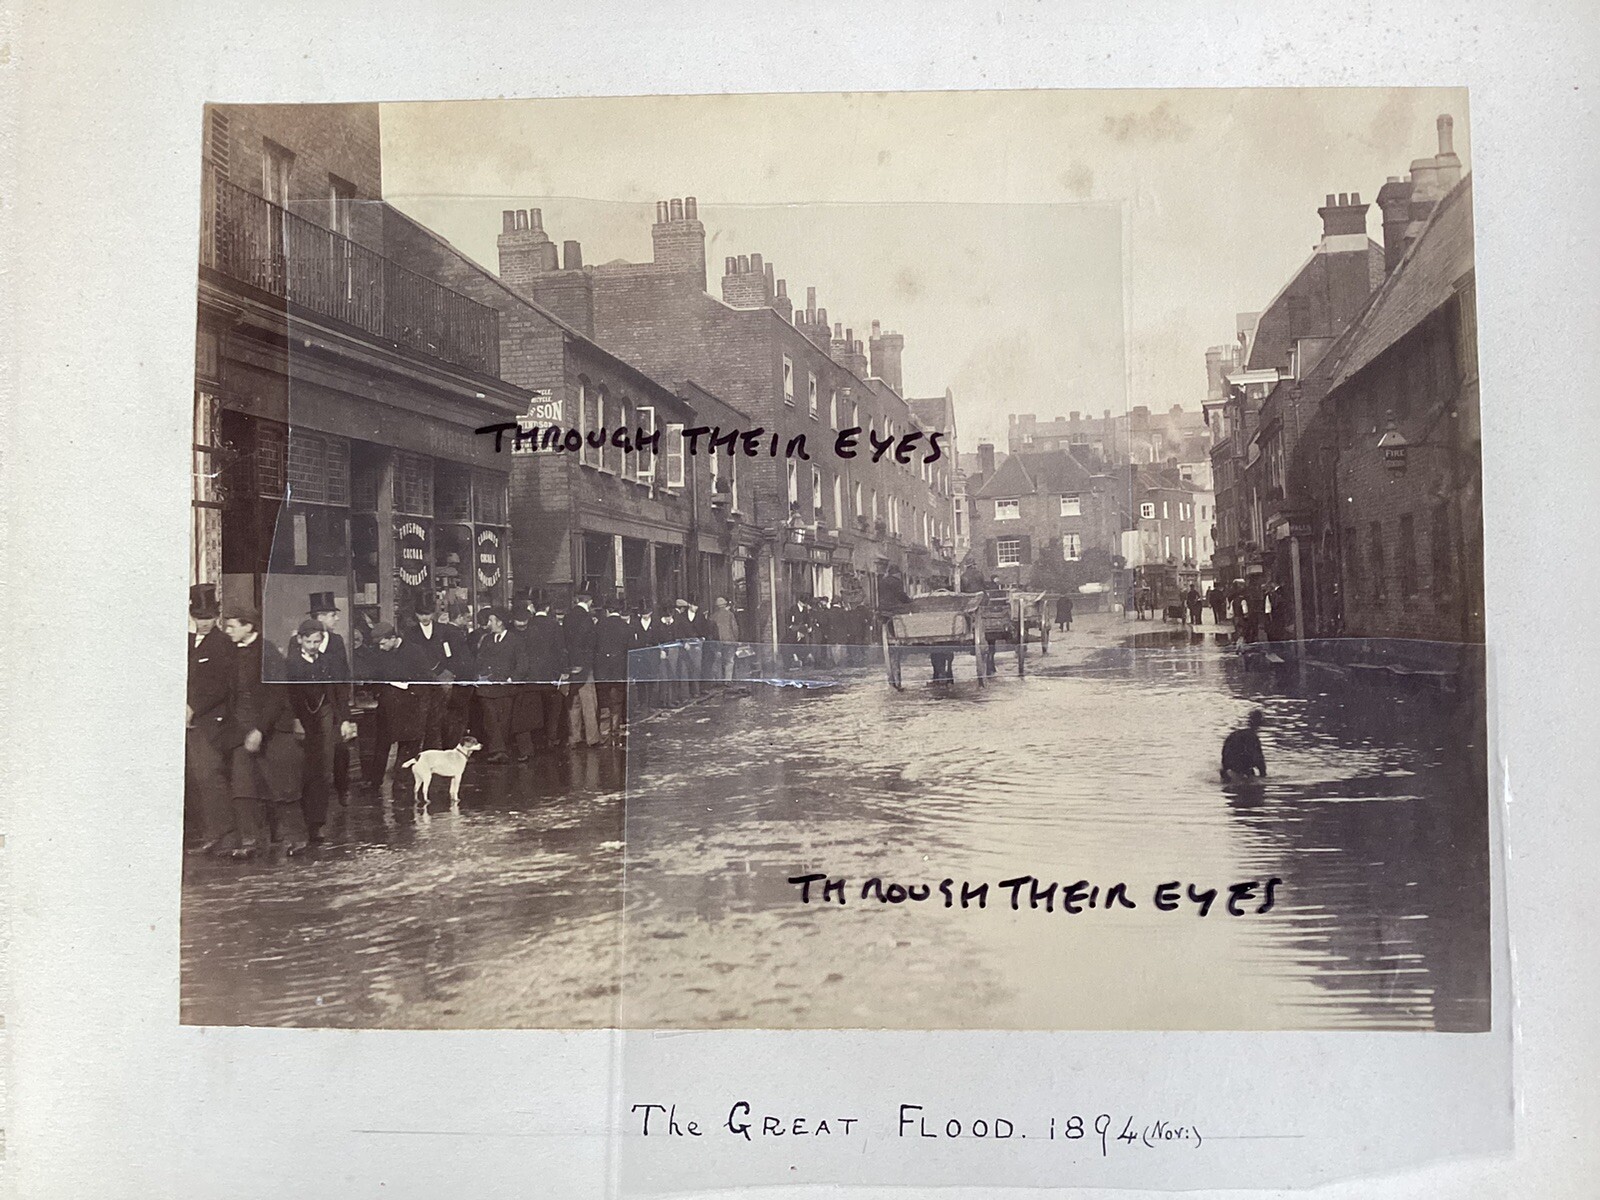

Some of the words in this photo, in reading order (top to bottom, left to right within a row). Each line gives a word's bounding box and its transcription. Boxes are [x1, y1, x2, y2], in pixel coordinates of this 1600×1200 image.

[537, 400, 563, 421] SON
[475, 423, 661, 455] THROUGH
[681, 426, 809, 461] THEIR
[834, 426, 944, 464] EYES
[400, 565, 428, 586] CHOCOLATE
[478, 567, 500, 587] CHOCOLATE
[999, 875, 1136, 914] THEIR
[1155, 880, 1284, 917] EYES
[632, 1103, 703, 1139] The
[727, 1101, 859, 1141] GREAT
[900, 1105, 1026, 1139] FLOOD.
